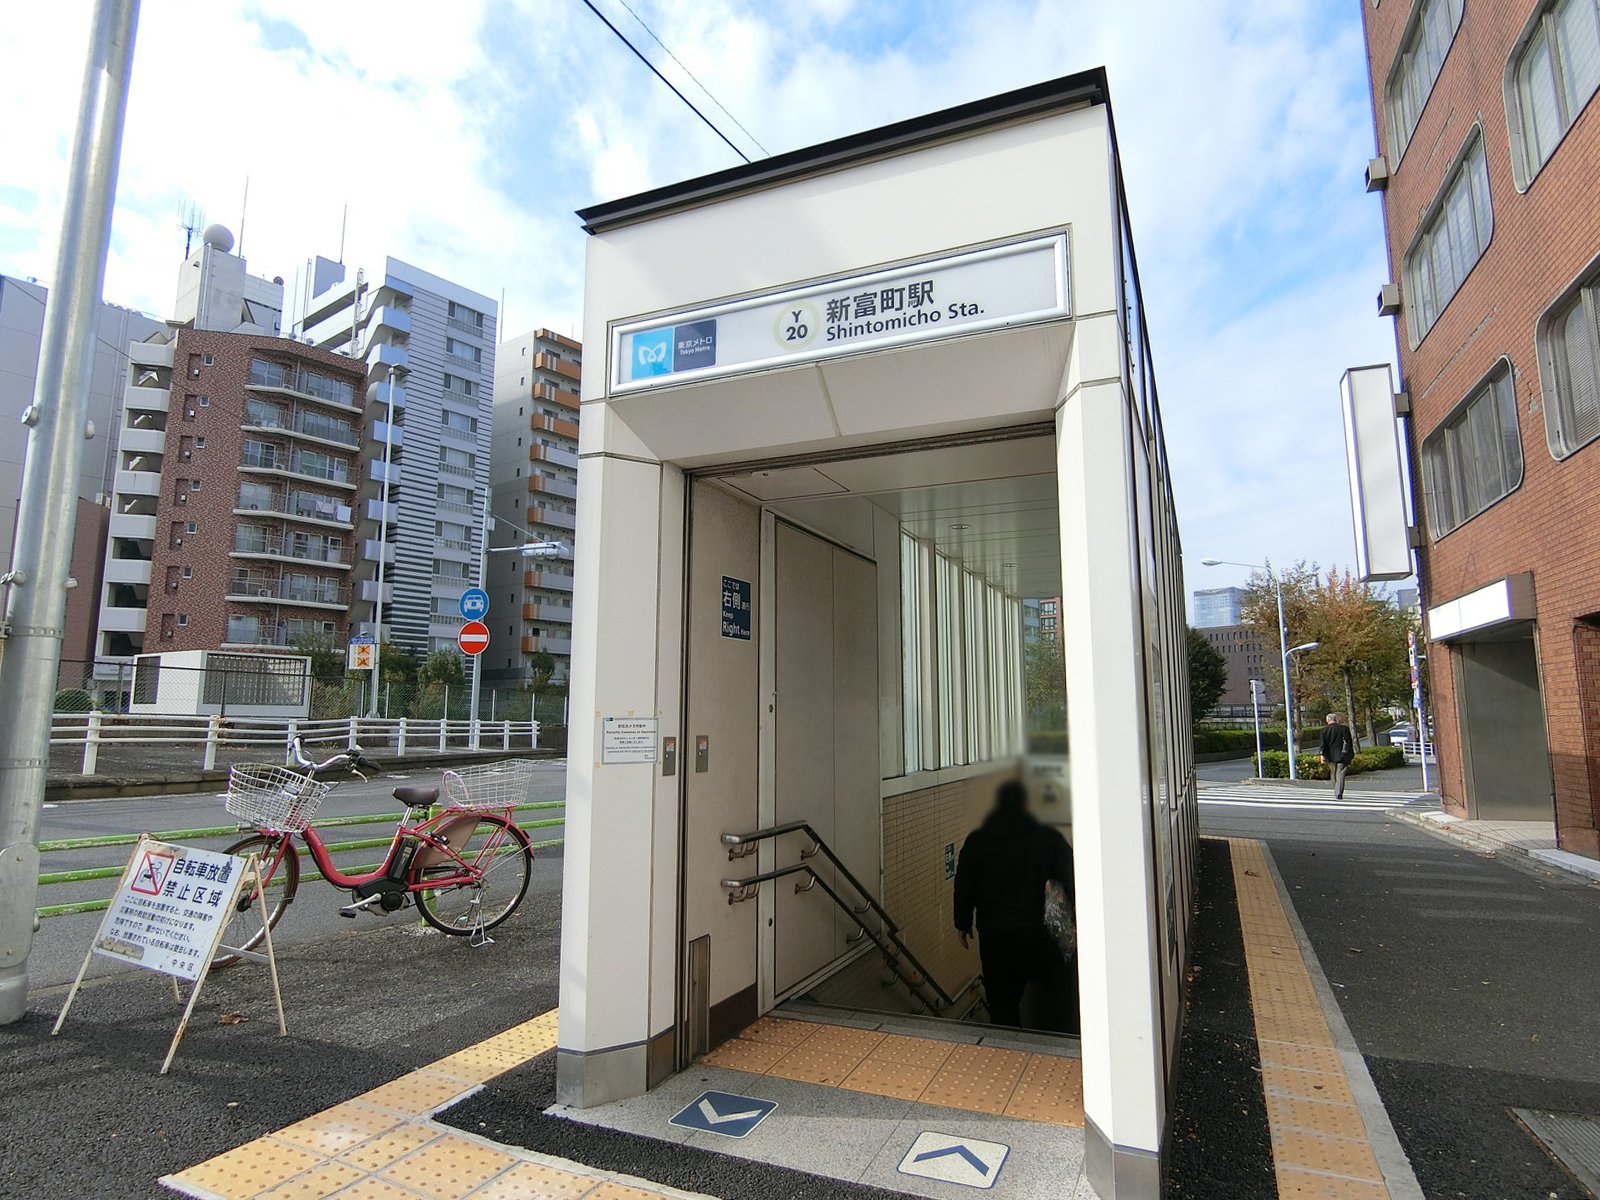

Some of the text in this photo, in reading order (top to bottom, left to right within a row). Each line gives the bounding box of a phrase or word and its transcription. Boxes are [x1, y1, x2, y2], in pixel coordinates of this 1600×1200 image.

[826, 279, 935, 323] 新富町駅
[791, 309, 803, 324] Y
[826, 301, 985, 341] Shintomicho Sta.
[786, 323, 808, 340] 20
[678, 336, 713, 350] 東京メトロ
[679, 348, 694, 356] Tokyo
[723, 621, 741, 636] Right
[173, 858, 233, 884] 自転車放置
[162, 880, 224, 907] 禁止区域
[171, 959, 195, 972] 中央区
